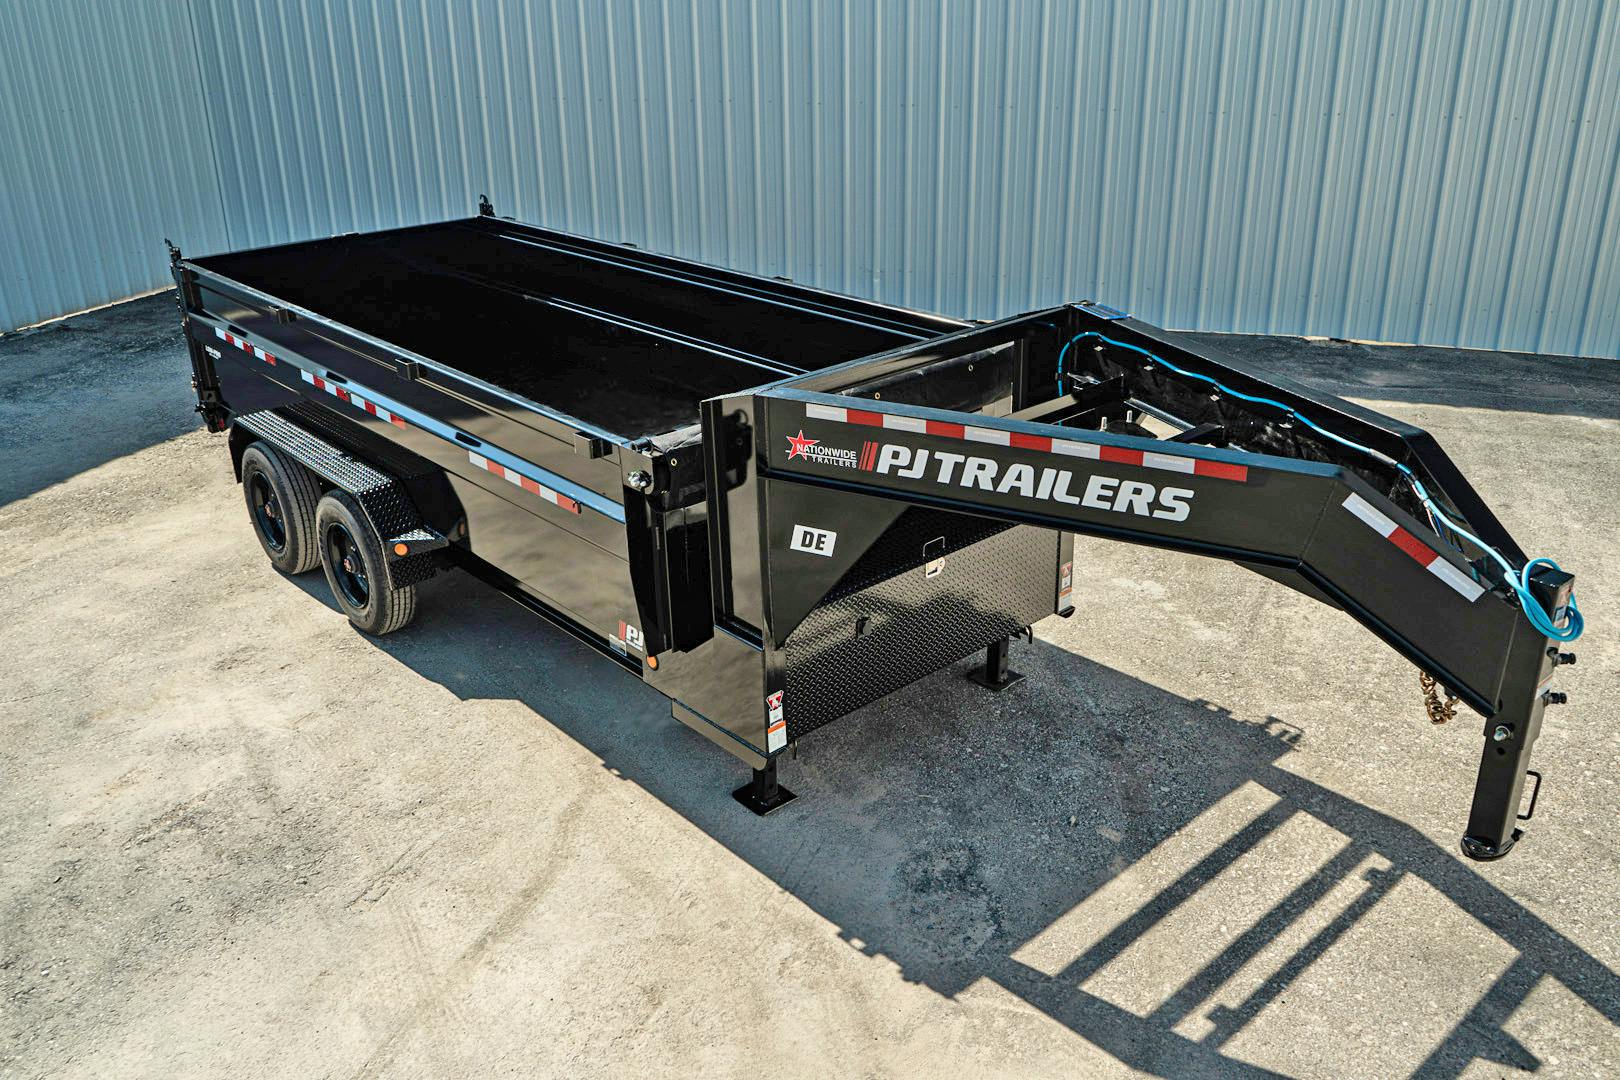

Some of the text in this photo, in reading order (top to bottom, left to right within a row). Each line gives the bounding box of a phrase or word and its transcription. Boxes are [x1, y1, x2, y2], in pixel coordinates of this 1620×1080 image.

[796, 443, 857, 460] NATIONWIDE
[812, 456, 857, 469] TRAILERS
[876, 444, 1195, 522] PJ TRAILERS
[801, 530, 827, 551] DE
